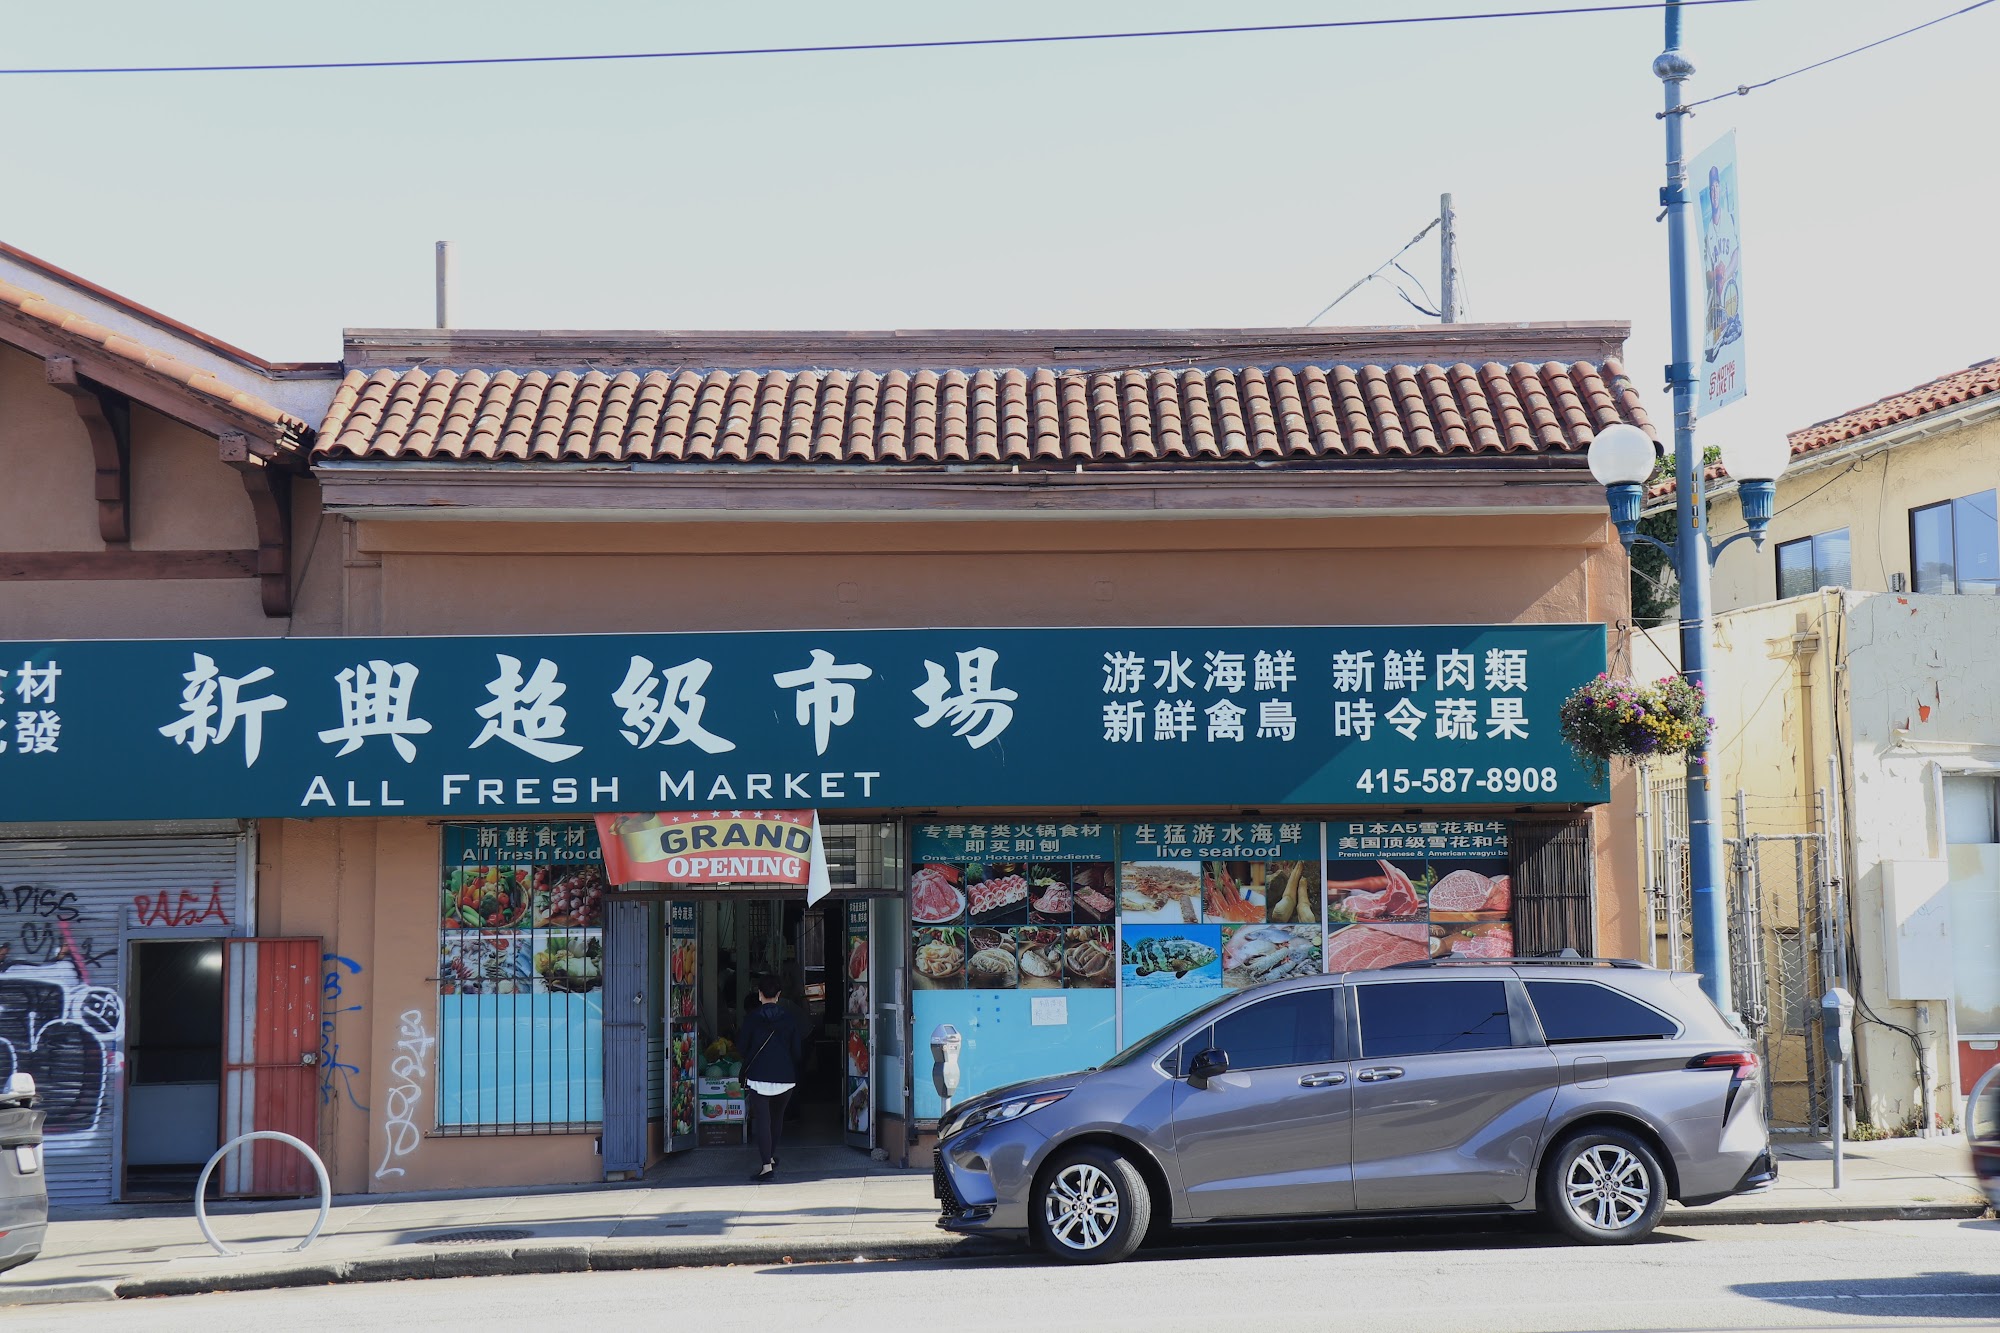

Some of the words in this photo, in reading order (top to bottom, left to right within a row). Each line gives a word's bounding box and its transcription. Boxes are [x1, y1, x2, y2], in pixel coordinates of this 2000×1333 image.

[0, 660, 62, 704] 材
[1102, 649, 1297, 694] 游水海鮮
[1332, 648, 1528, 693] 新鮮肉類
[158, 646, 1019, 769] 新興超級市場
[1103, 698, 1297, 743] 新鮮禽鳥
[1334, 697, 1529, 741] 時令蔬果
[0, 710, 62, 754] 發
[301, 775, 404, 806] ALL
[443, 774, 618, 805] FRESH
[660, 770, 880, 801] MARKET
[1356, 766, 1558, 794] 415-587-8908
[477, 827, 585, 848] 新鲜食材
[660, 823, 811, 854] GRAND
[922, 824, 1102, 839] 专营各类火锅食材
[1135, 823, 1302, 844] 生猛游水海鲜
[1349, 821, 1507, 835] 日本A5雪花和牛
[463, 849, 489, 861] All
[495, 849, 547, 861] fresh
[554, 848, 601, 861] food
[1156, 845, 1193, 857] live
[1198, 845, 1281, 857] seafood
[1377, 850, 1415, 858] Japanese
[667, 857, 801, 878] OPENING
